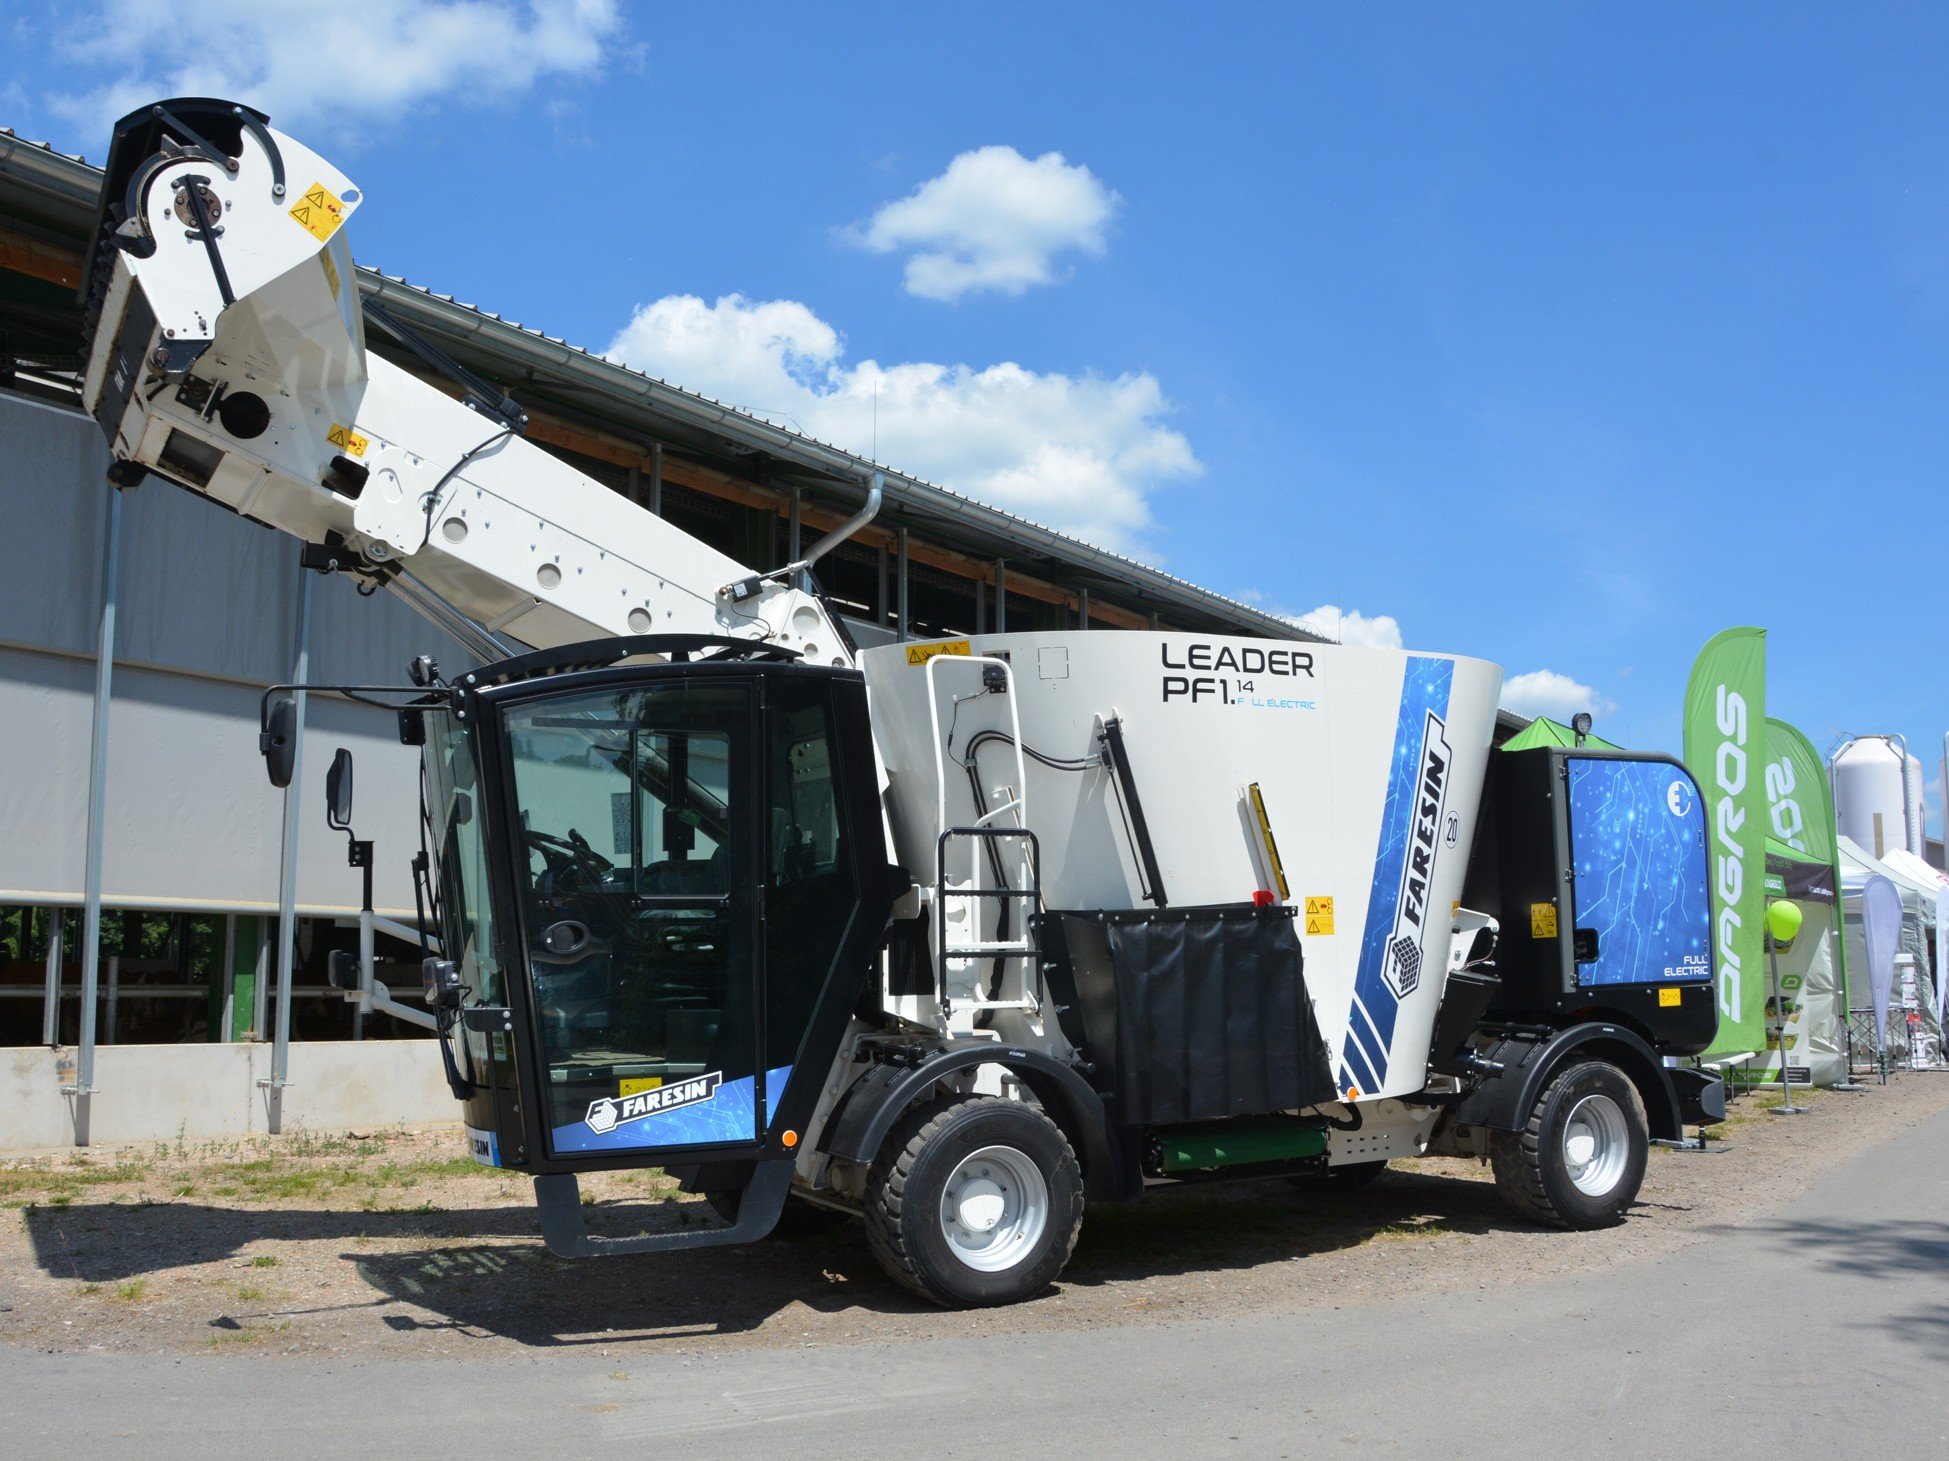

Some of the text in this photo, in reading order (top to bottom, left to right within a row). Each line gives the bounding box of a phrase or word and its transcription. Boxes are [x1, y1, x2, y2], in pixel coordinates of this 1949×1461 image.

[1162, 643, 1315, 678] LEADER
[1267, 699, 1317, 710] ELECTRIC
[1404, 748, 1446, 928] FARESIN
[1446, 816, 1458, 842] 20
[1716, 684, 1747, 1024] DAGROS
[1664, 965, 1709, 977] ELECTRIC
[1683, 955, 1709, 965] FULL
[622, 1079, 708, 1119] FARESIN
